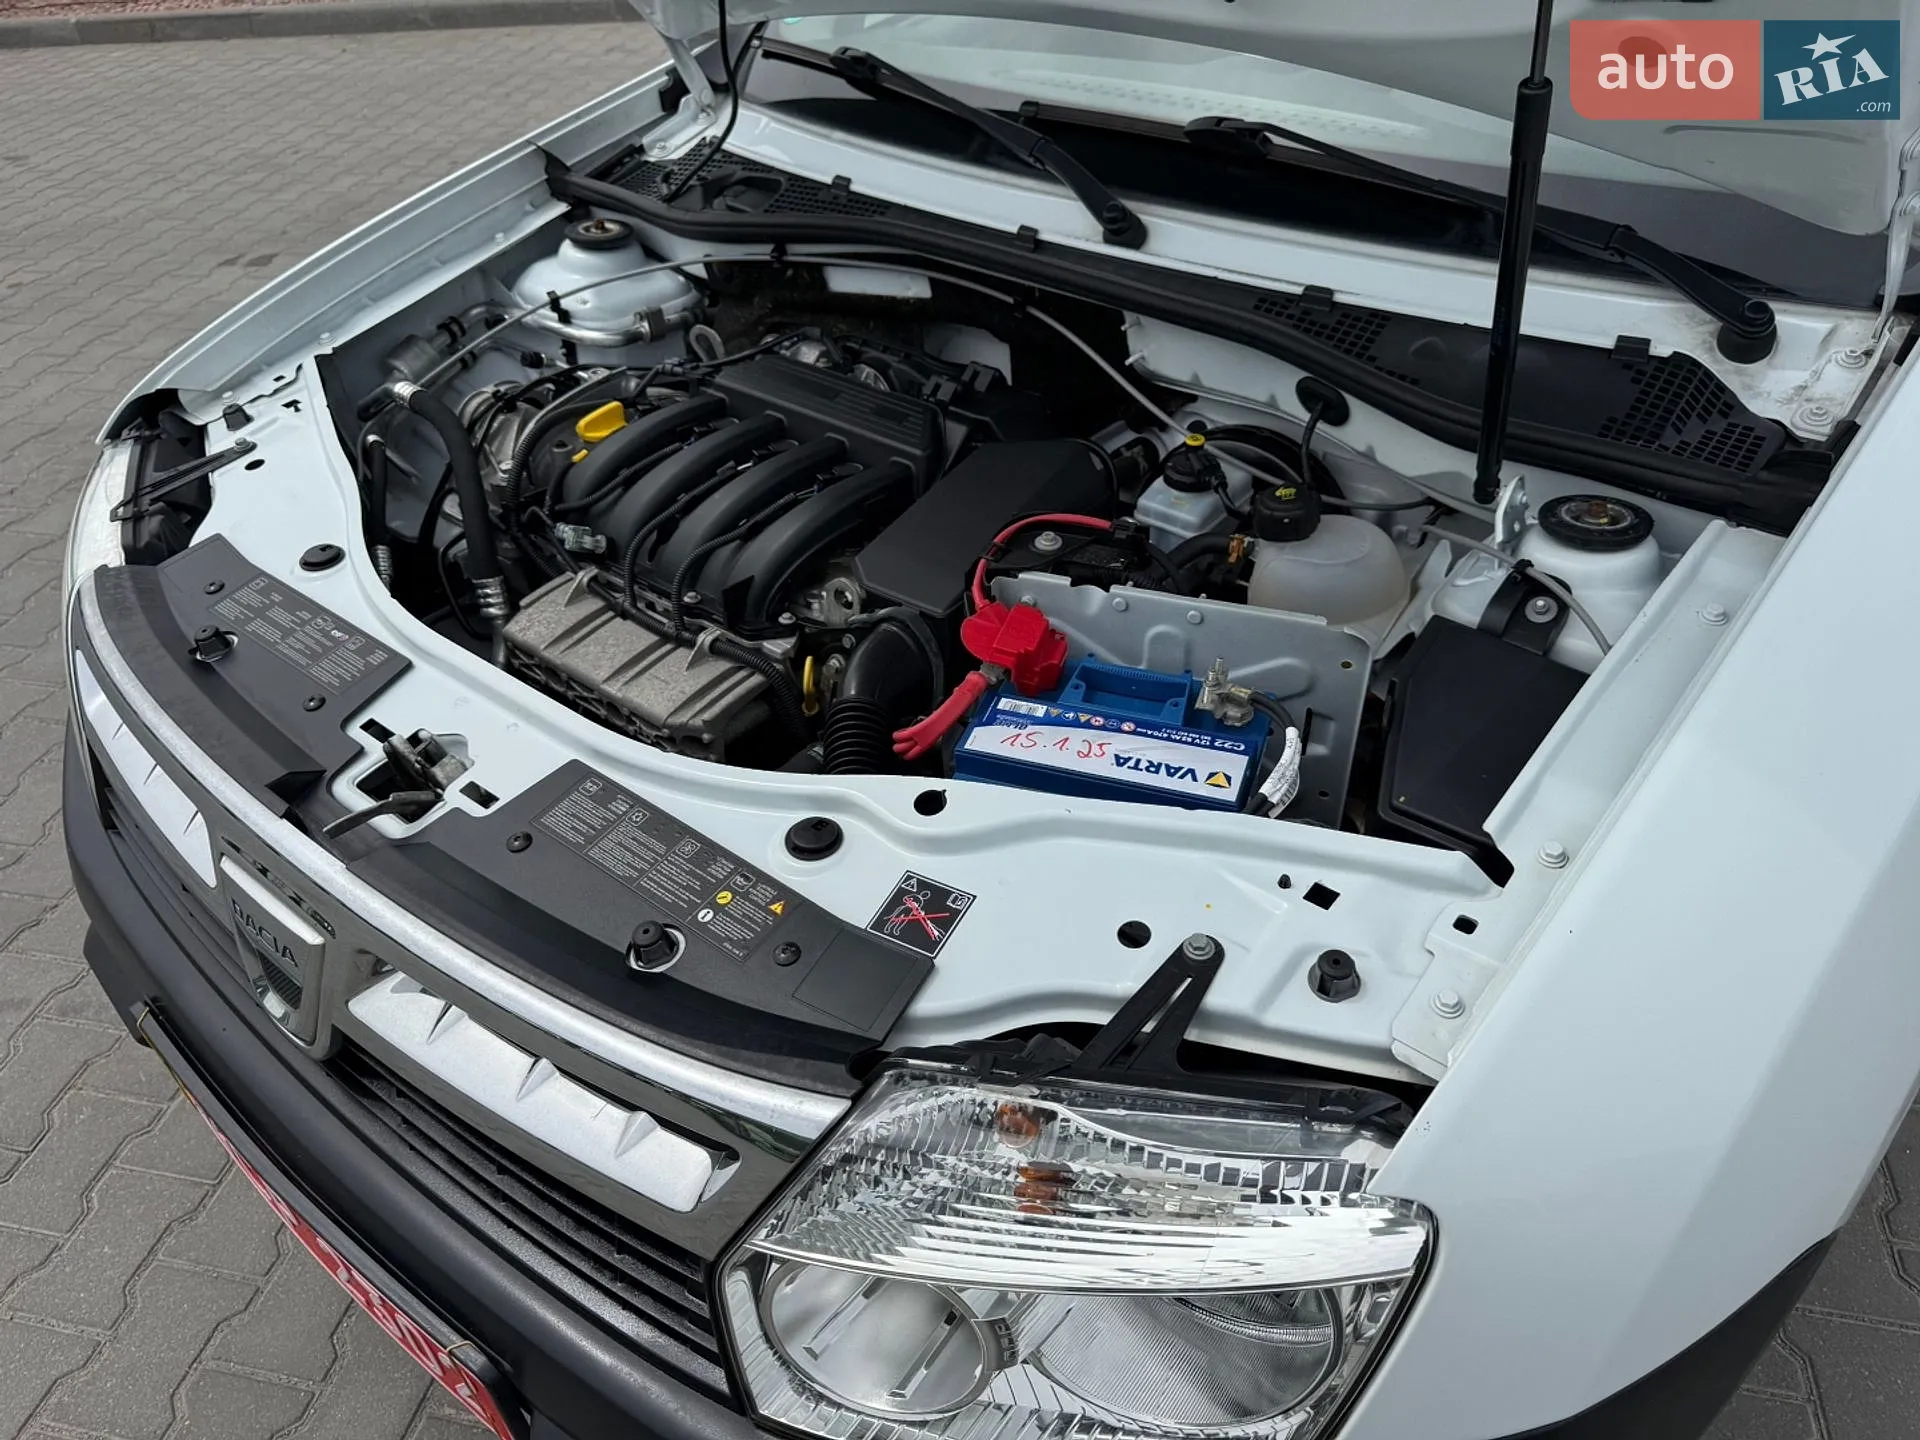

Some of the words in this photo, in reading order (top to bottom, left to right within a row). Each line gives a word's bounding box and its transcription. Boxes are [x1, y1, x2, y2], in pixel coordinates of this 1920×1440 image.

[1213, 738, 1246, 751] C22
[1114, 753, 1199, 783] VARTA
[230, 896, 299, 968] DACIA
